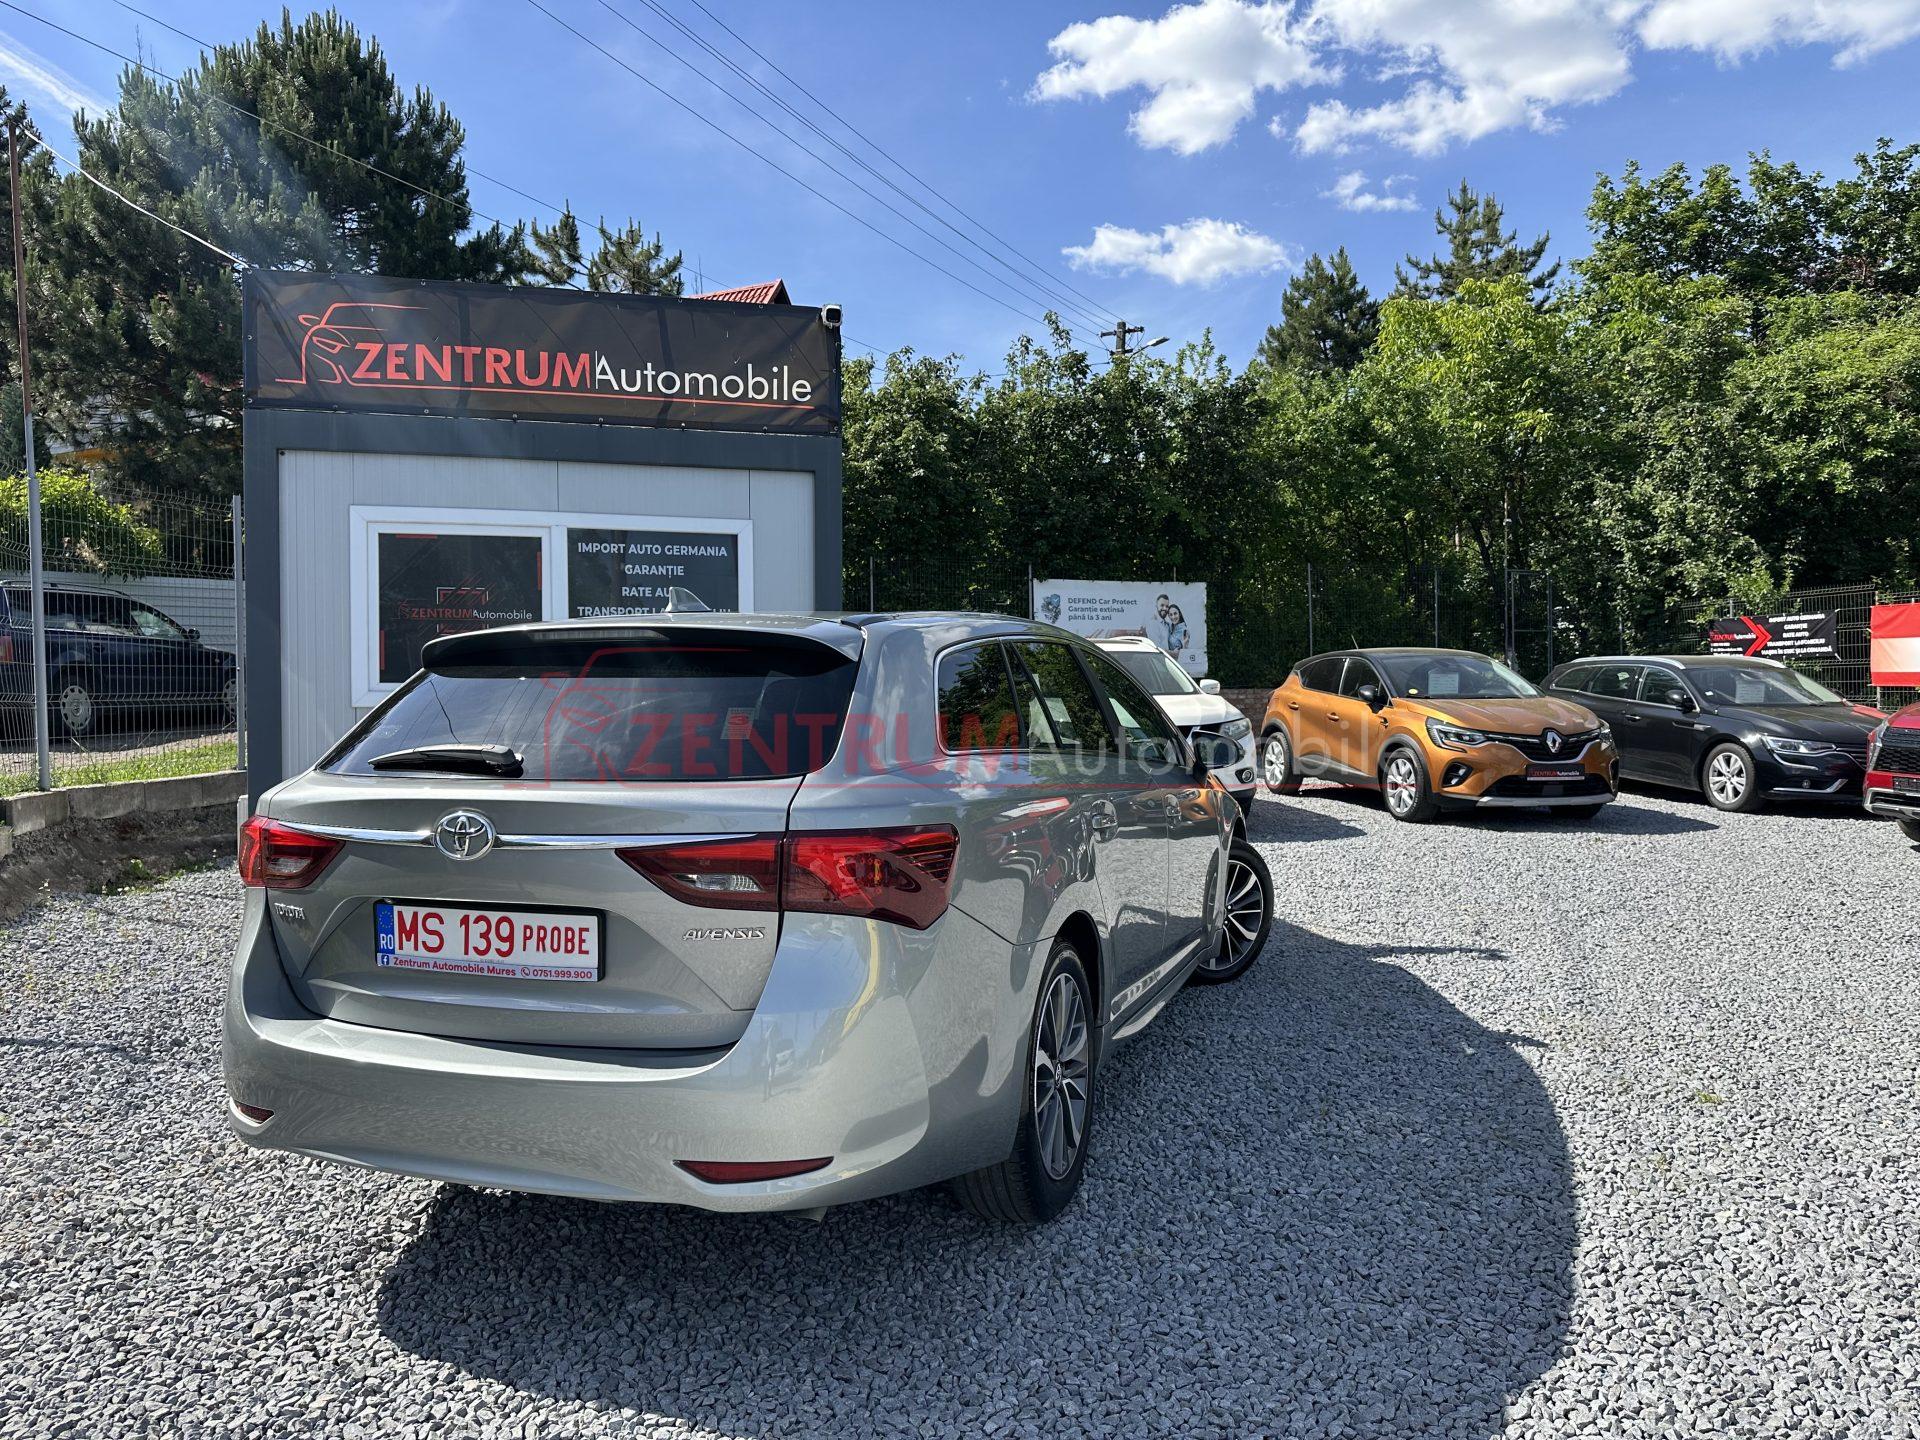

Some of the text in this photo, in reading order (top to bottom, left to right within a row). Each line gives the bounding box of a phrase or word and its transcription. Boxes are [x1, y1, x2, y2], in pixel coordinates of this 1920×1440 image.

[352, 341, 812, 402] ZENTRUM Automobile
[577, 542, 728, 557] IMPORT AUTO GERMANIA
[624, 564, 685, 578] GARANȚIE
[621, 586, 670, 597] RATE AU
[1067, 597, 1097, 605] DEFEND
[411, 607, 533, 620] ZENTRUM Automobile
[379, 910, 590, 958] RO MS 139 PROBE
[682, 927, 766, 941] AVENSIS
[393, 957, 431, 969] Zentrum
[432, 962, 485, 974] Automobile
[487, 966, 516, 977] Mures
[532, 968, 593, 979] 0751.999.900
